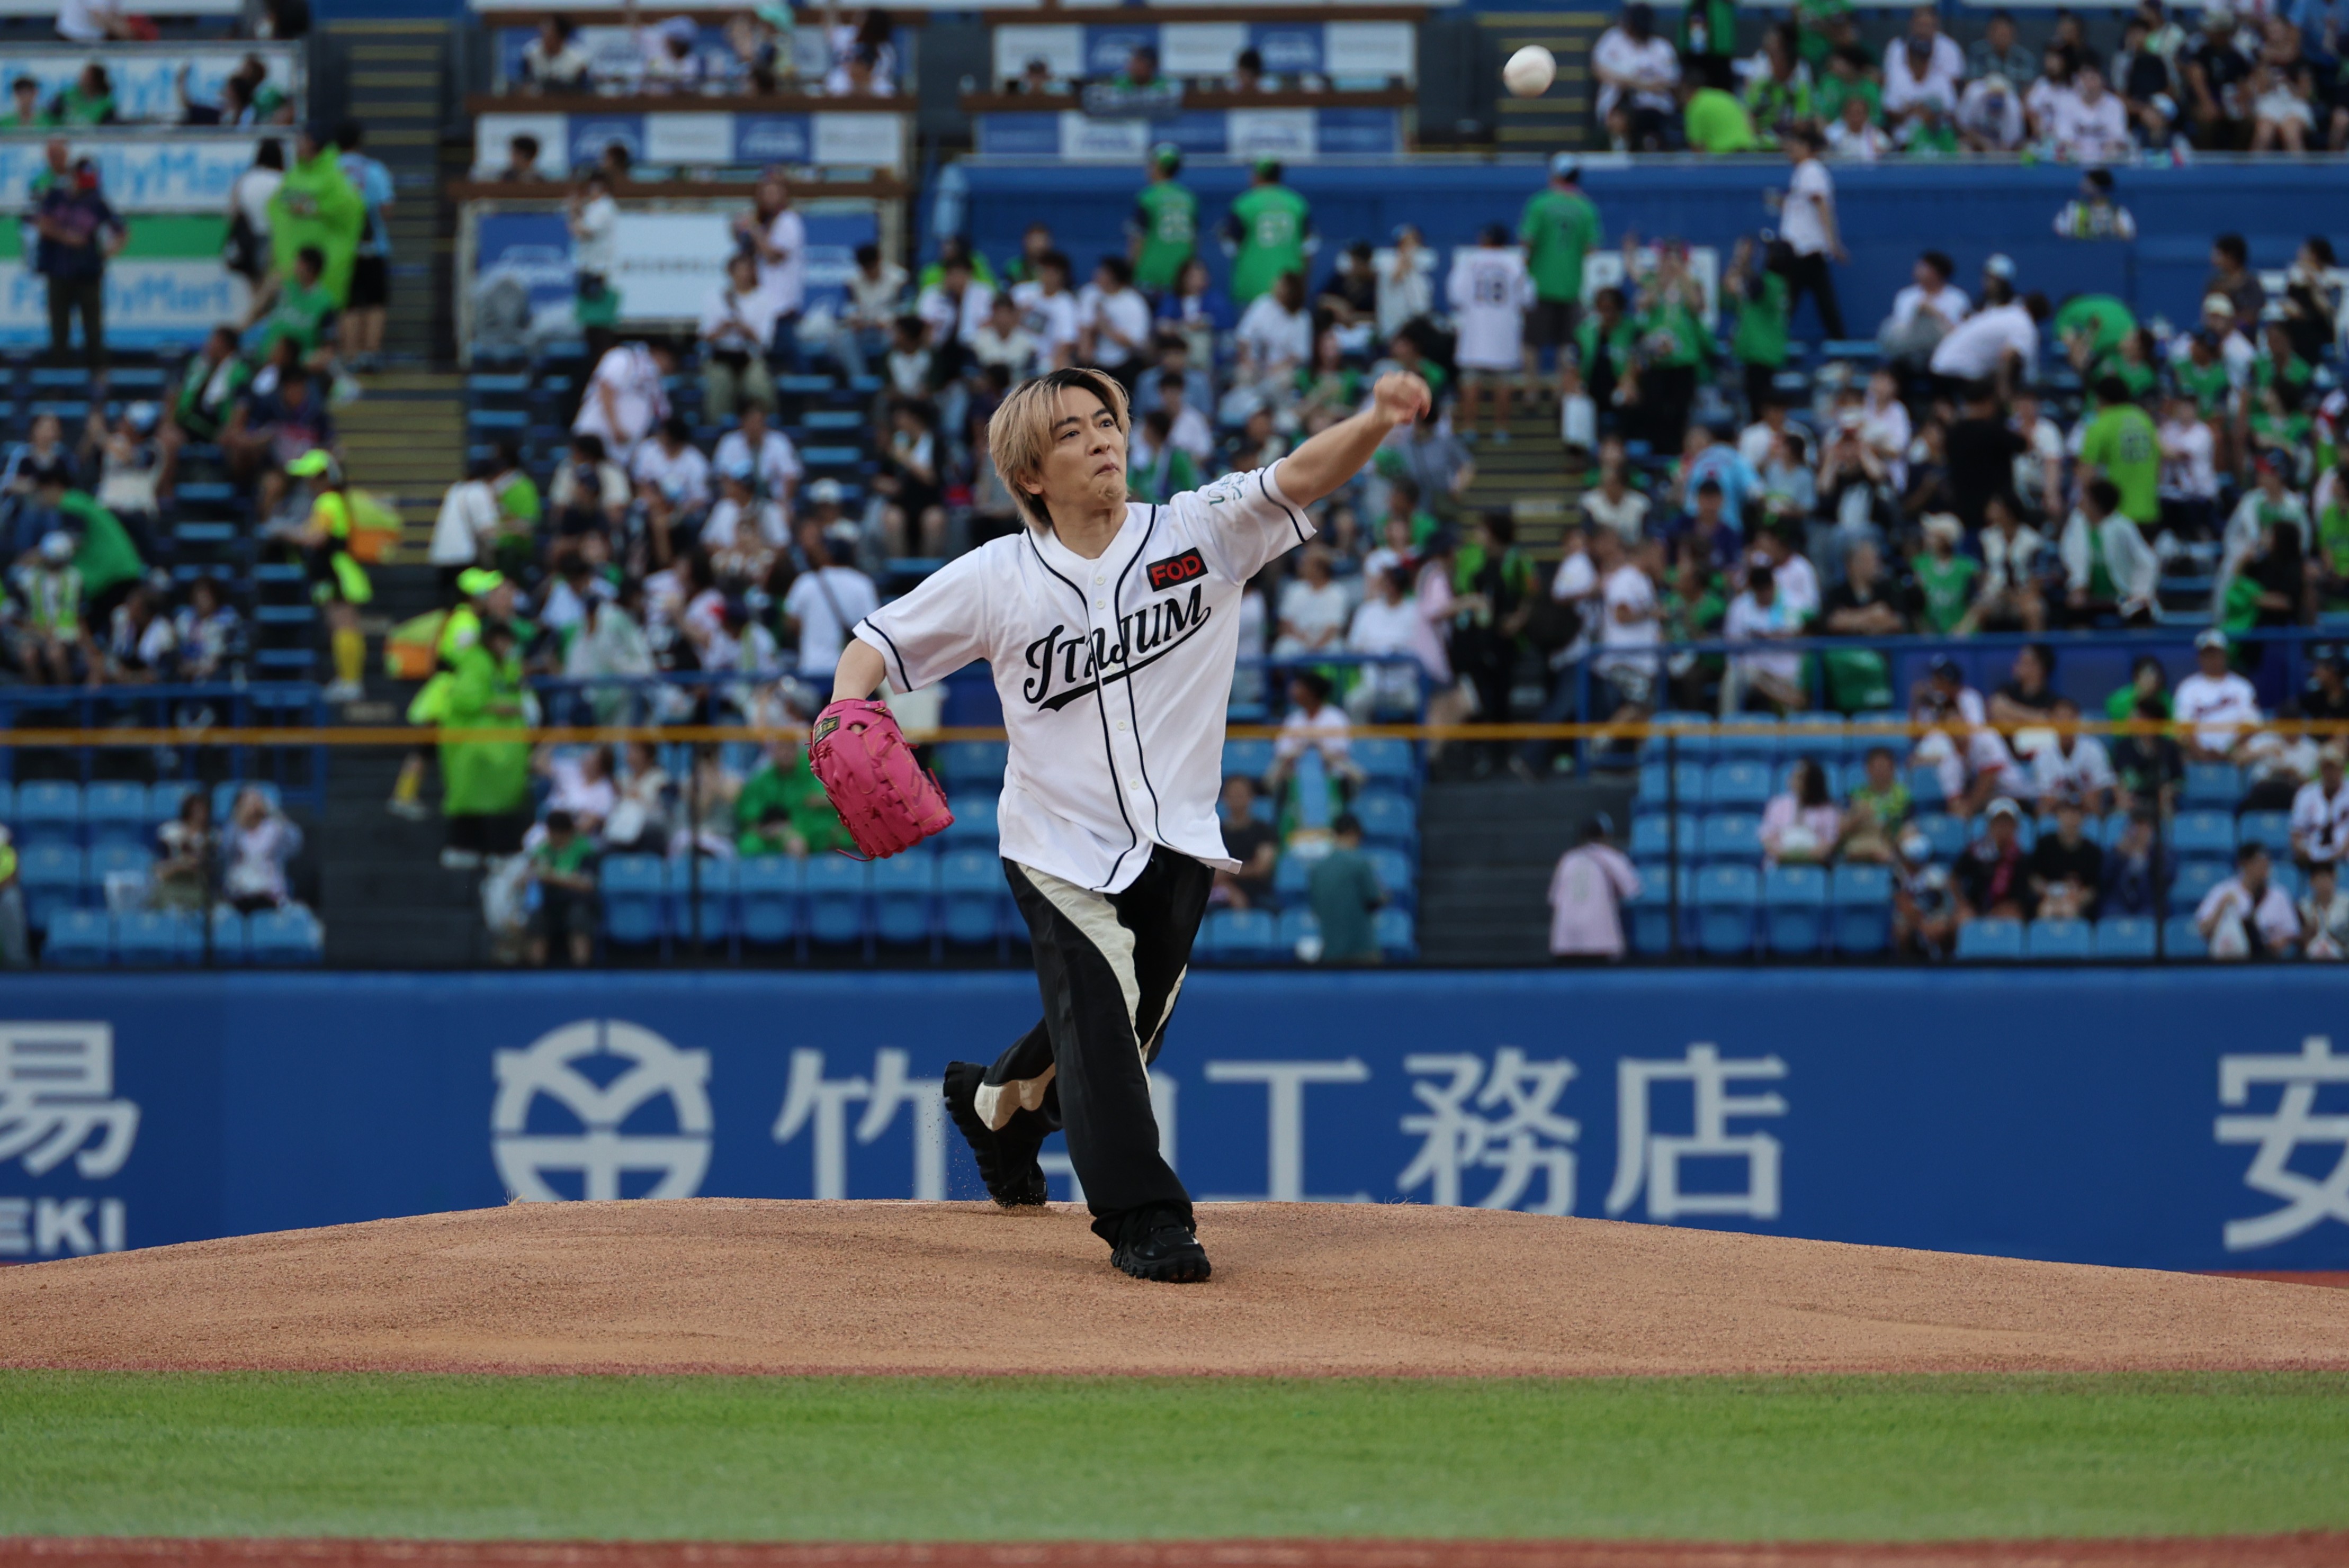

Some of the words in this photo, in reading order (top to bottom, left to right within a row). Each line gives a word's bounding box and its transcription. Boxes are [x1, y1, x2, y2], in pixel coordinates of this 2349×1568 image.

[1151, 555, 1201, 586] FOD
[0, 1021, 141, 1179] 易
[2214, 1035, 2349, 1252] 安
